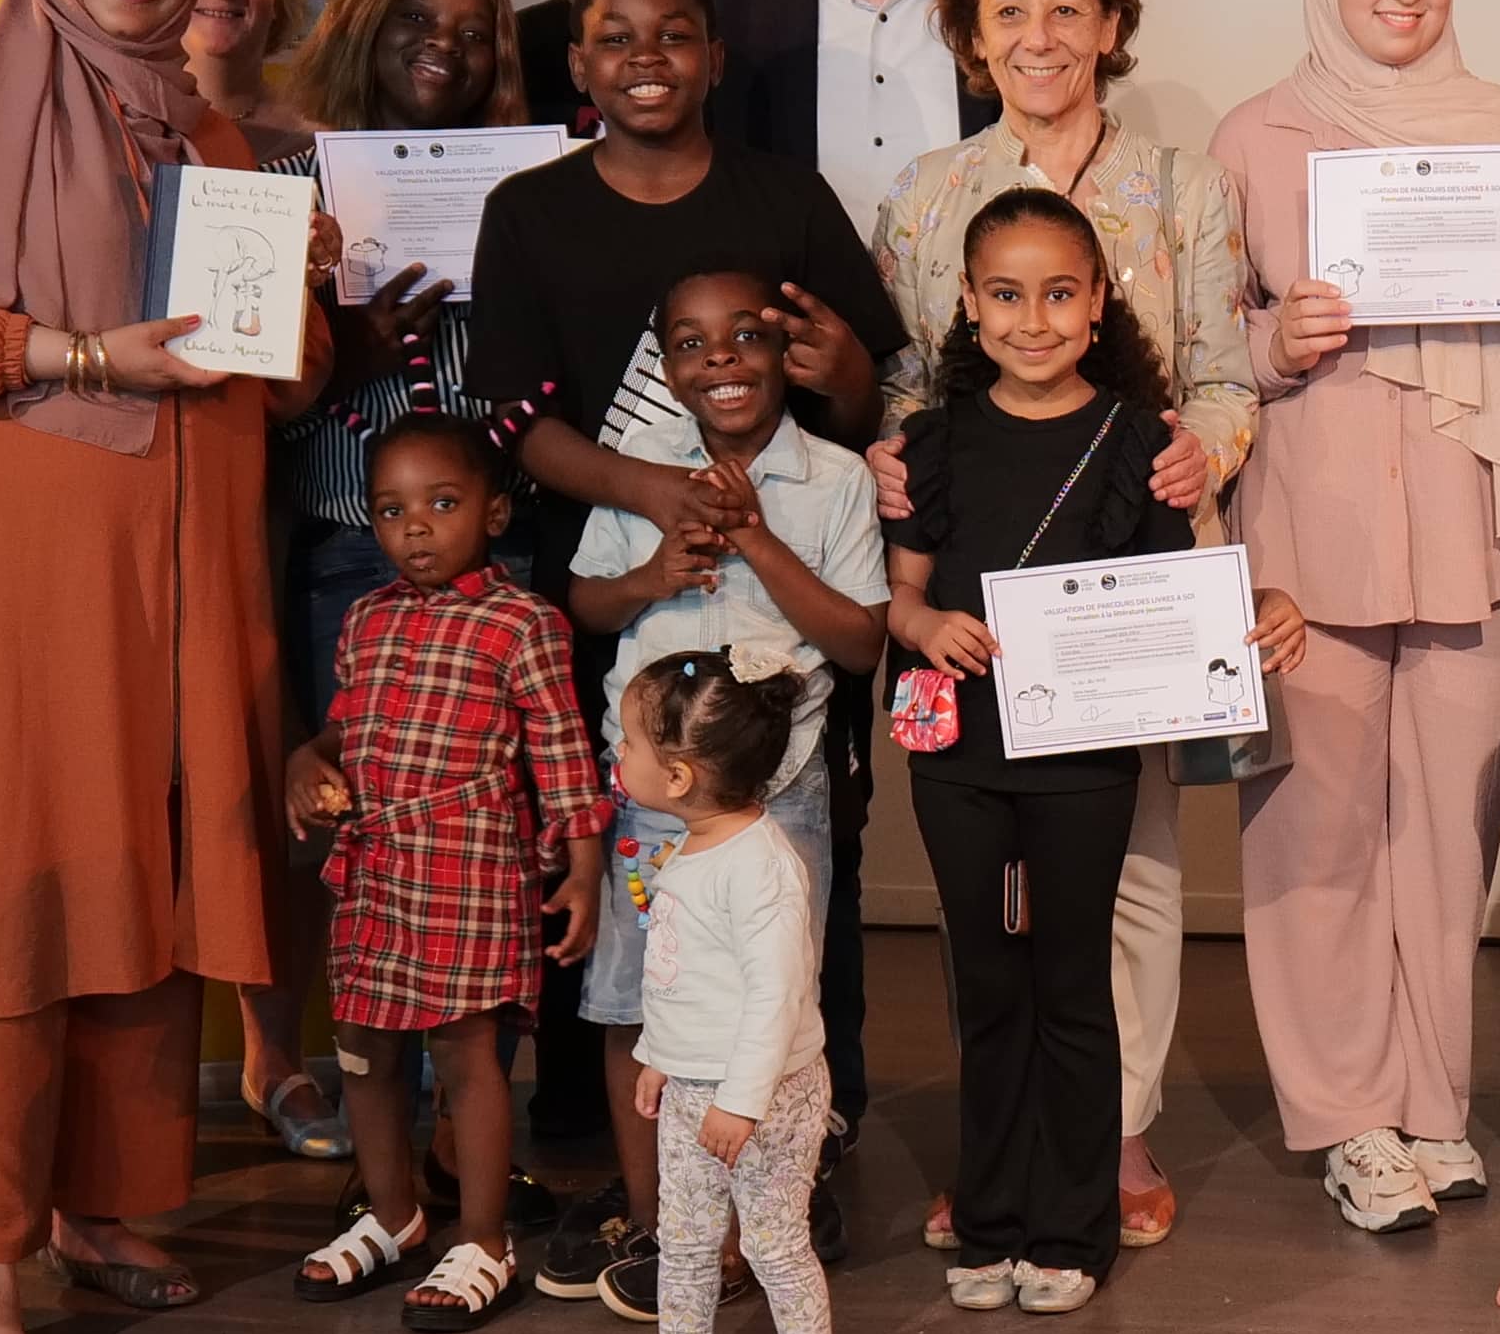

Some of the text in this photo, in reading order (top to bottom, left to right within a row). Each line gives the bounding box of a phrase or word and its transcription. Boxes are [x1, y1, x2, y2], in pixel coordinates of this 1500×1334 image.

[1097, 599, 1136, 610] PARCOURS
[1137, 598, 1151, 606] DES
[1152, 595, 1176, 604] LIVRES
